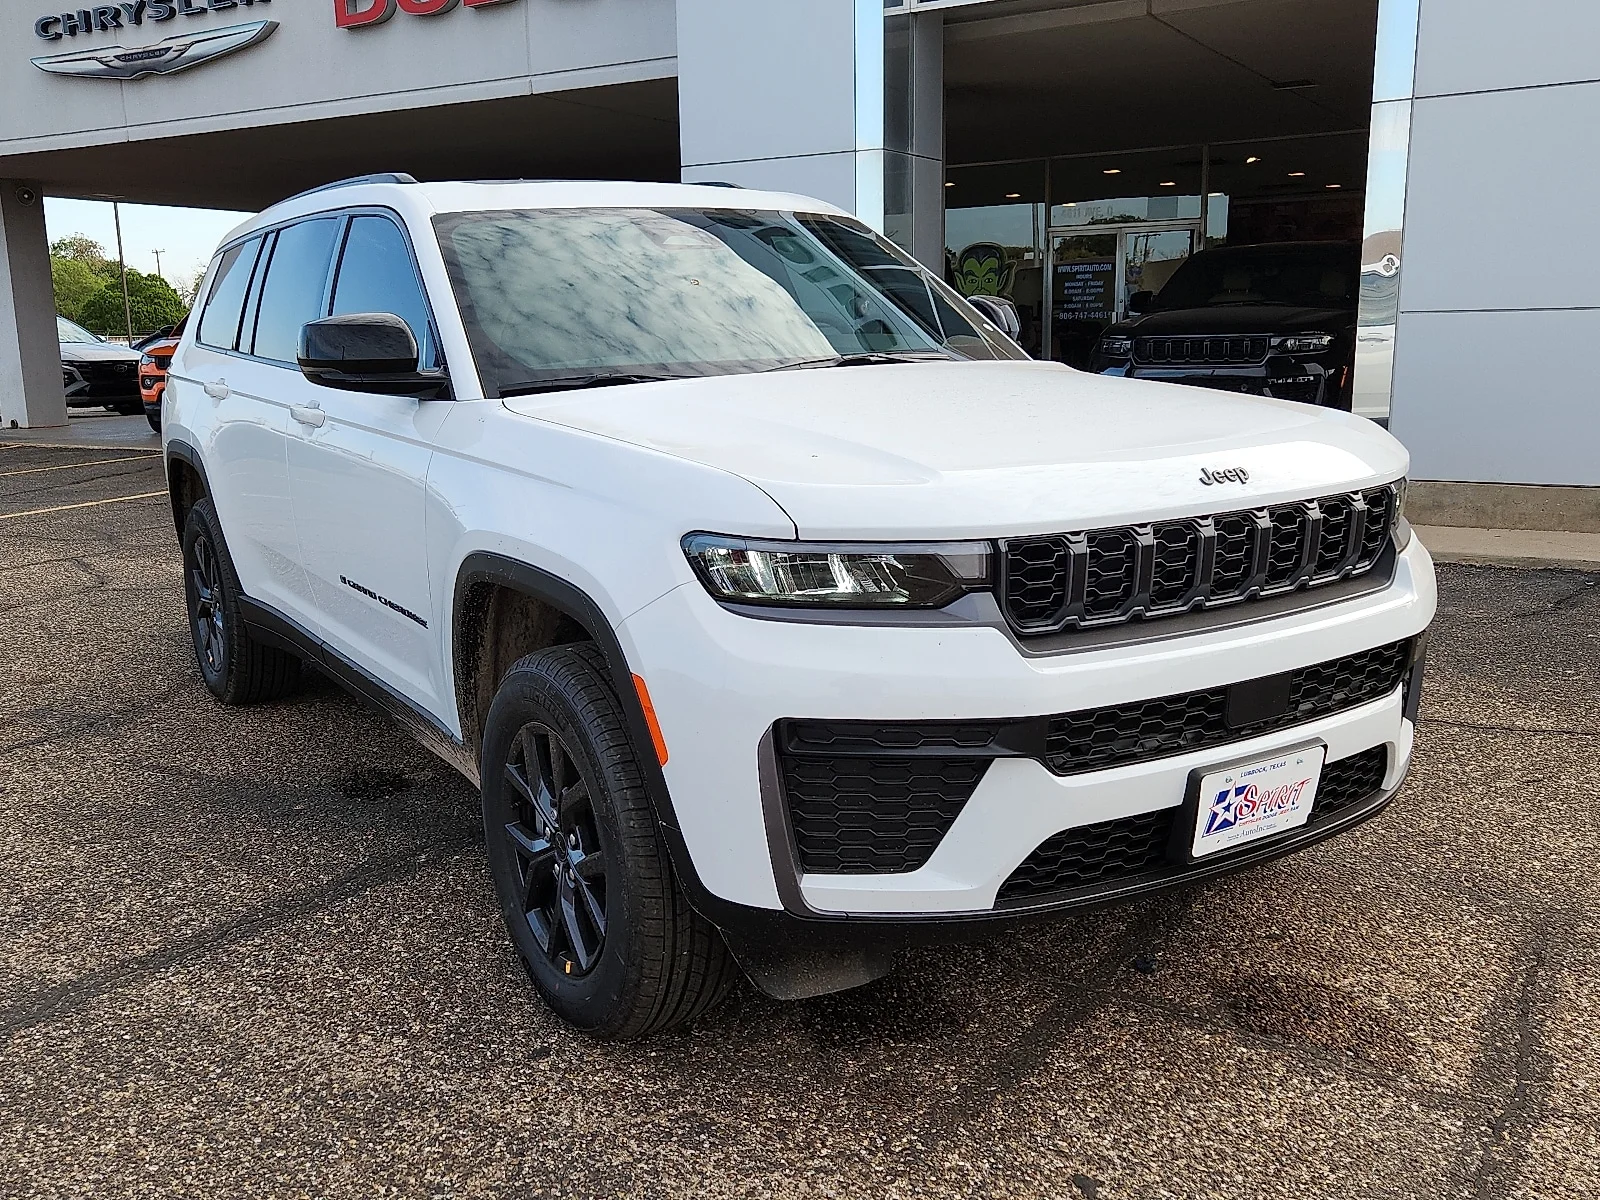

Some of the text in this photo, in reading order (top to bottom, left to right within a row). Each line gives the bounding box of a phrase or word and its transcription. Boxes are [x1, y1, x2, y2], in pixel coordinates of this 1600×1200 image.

[34, 0, 270, 40] CHRYSL
[120, 50, 166, 61] CHRYSLER
[1057, 263, 1112, 273] WWW.SPIRITAUTO.COM
[1199, 467, 1249, 486] Jeep
[347, 579, 378, 601] GRAND
[1269, 761, 1287, 771] TEXAS
[1238, 778, 1312, 817] SPIRIT
[1262, 812, 1278, 820] DODGE
